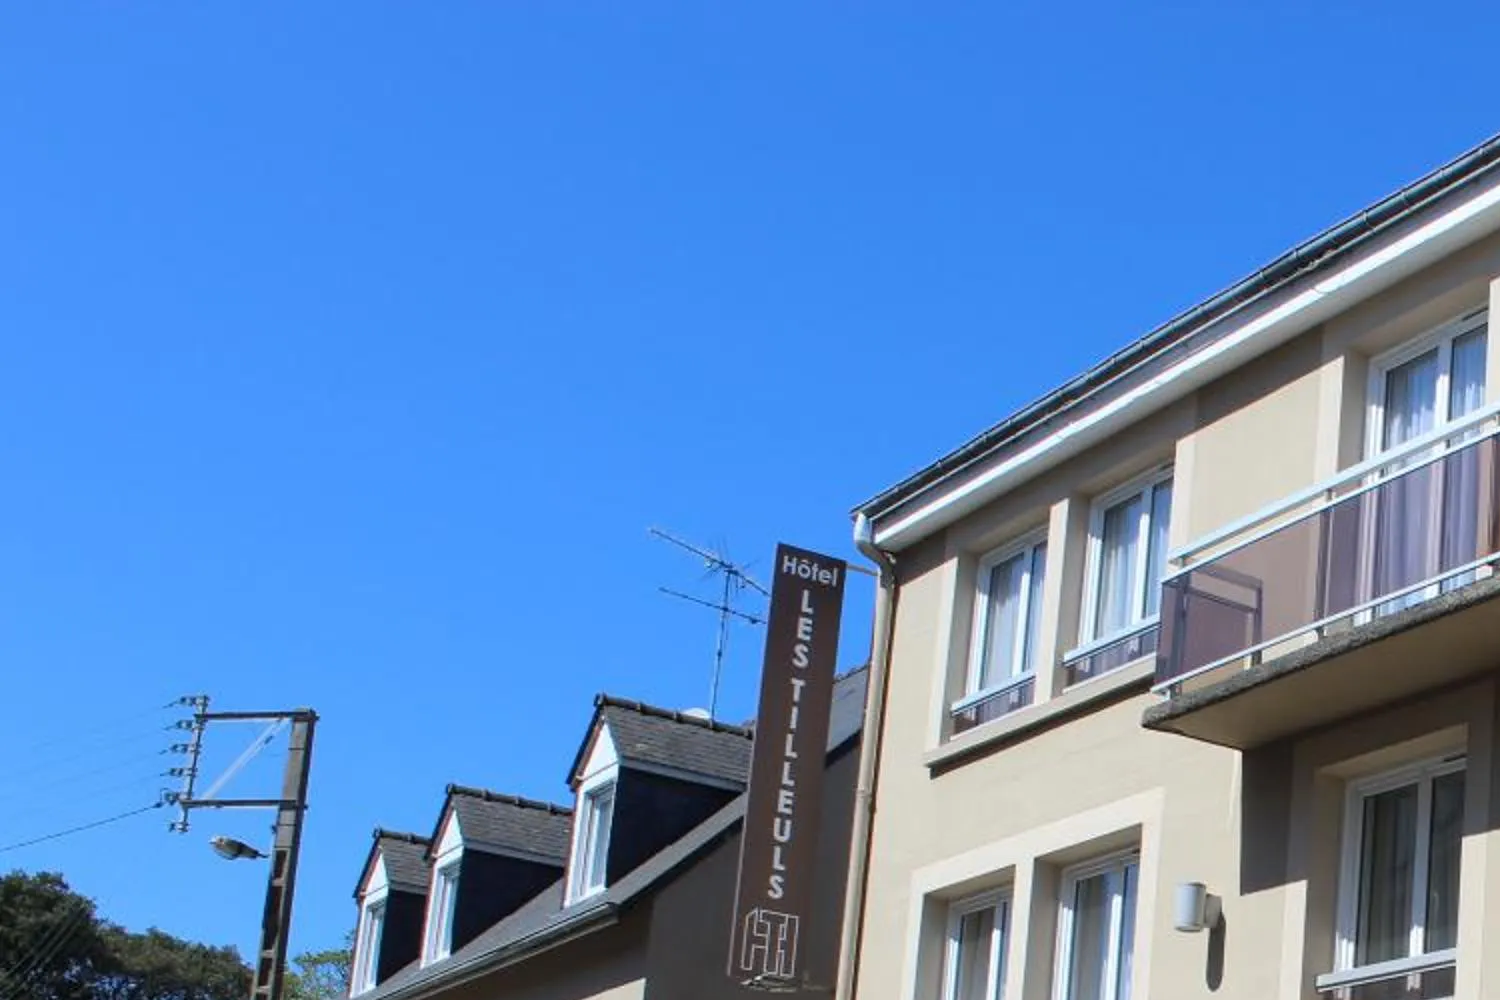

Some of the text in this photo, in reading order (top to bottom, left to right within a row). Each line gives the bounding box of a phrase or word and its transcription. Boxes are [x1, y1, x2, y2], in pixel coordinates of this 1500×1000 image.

[782, 554, 839, 587] Hôtel
[767, 589, 814, 899] LES TILLEULS
